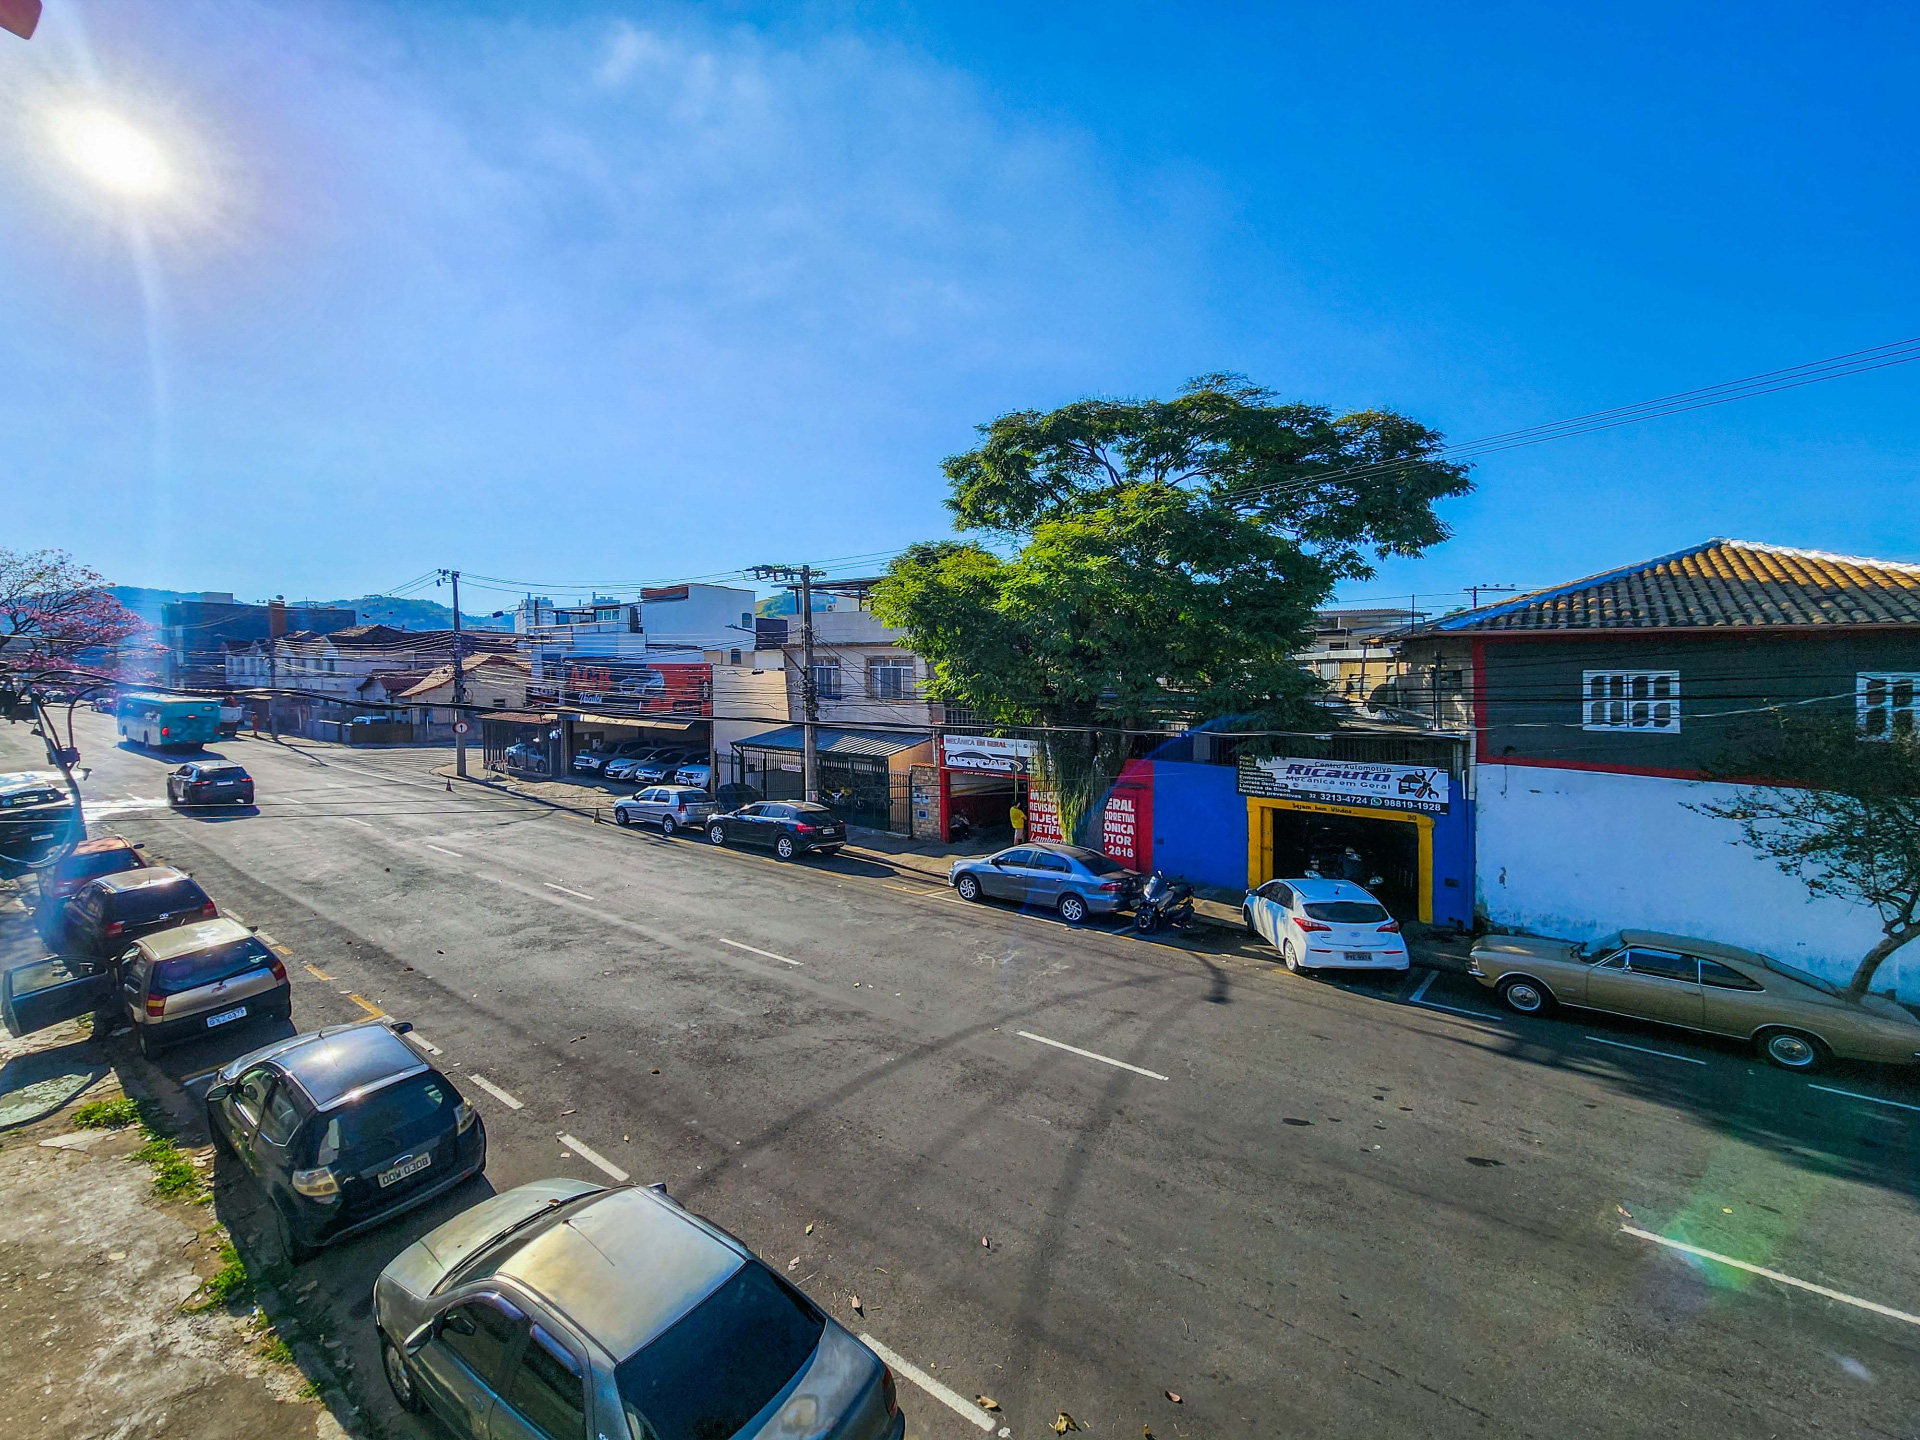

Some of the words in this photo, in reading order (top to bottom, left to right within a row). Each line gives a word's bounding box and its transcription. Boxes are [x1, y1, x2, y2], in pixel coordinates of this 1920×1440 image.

[945, 737, 975, 746] MECÂNICA
[987, 740, 1007, 748] GERAL
[1286, 763, 1392, 782] Ricauto
[1314, 761, 1342, 769] Centro
[1344, 764, 1392, 772] Automotivo
[1286, 775, 1335, 785] Mecânica
[1360, 781, 1391, 790] Geral
[1320, 793, 1368, 804] 3213-4724
[1384, 799, 1442, 811] 98819-1928
[1108, 845, 1134, 858] 2818
